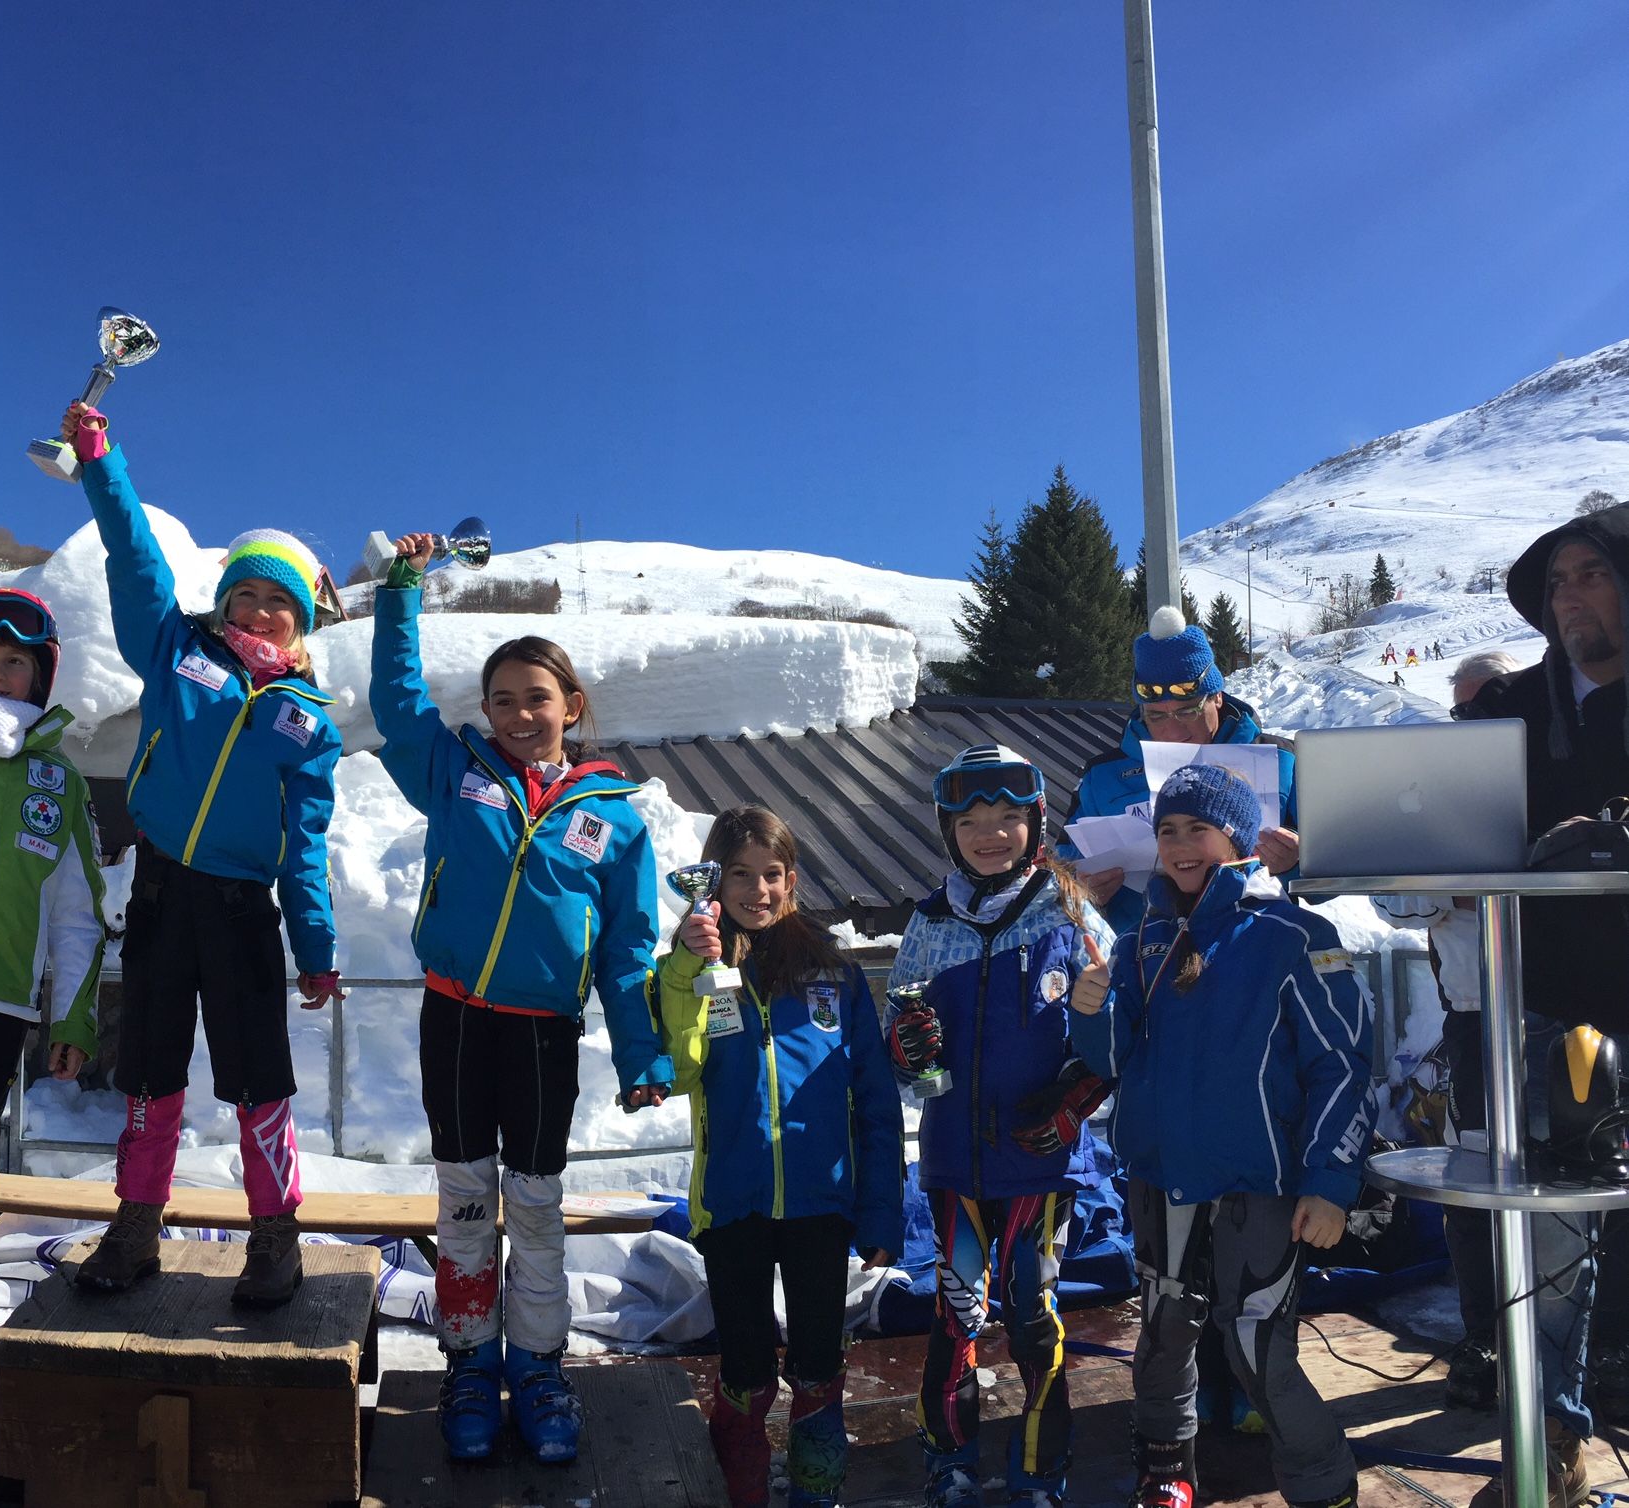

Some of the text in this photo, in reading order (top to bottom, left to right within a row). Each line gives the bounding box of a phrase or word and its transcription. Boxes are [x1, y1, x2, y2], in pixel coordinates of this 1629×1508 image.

[28, 839, 50, 853] MARI
[715, 998, 732, 1006] SOA
[707, 1006, 731, 1015] TERMICA
[1332, 1100, 1371, 1164] HEY
